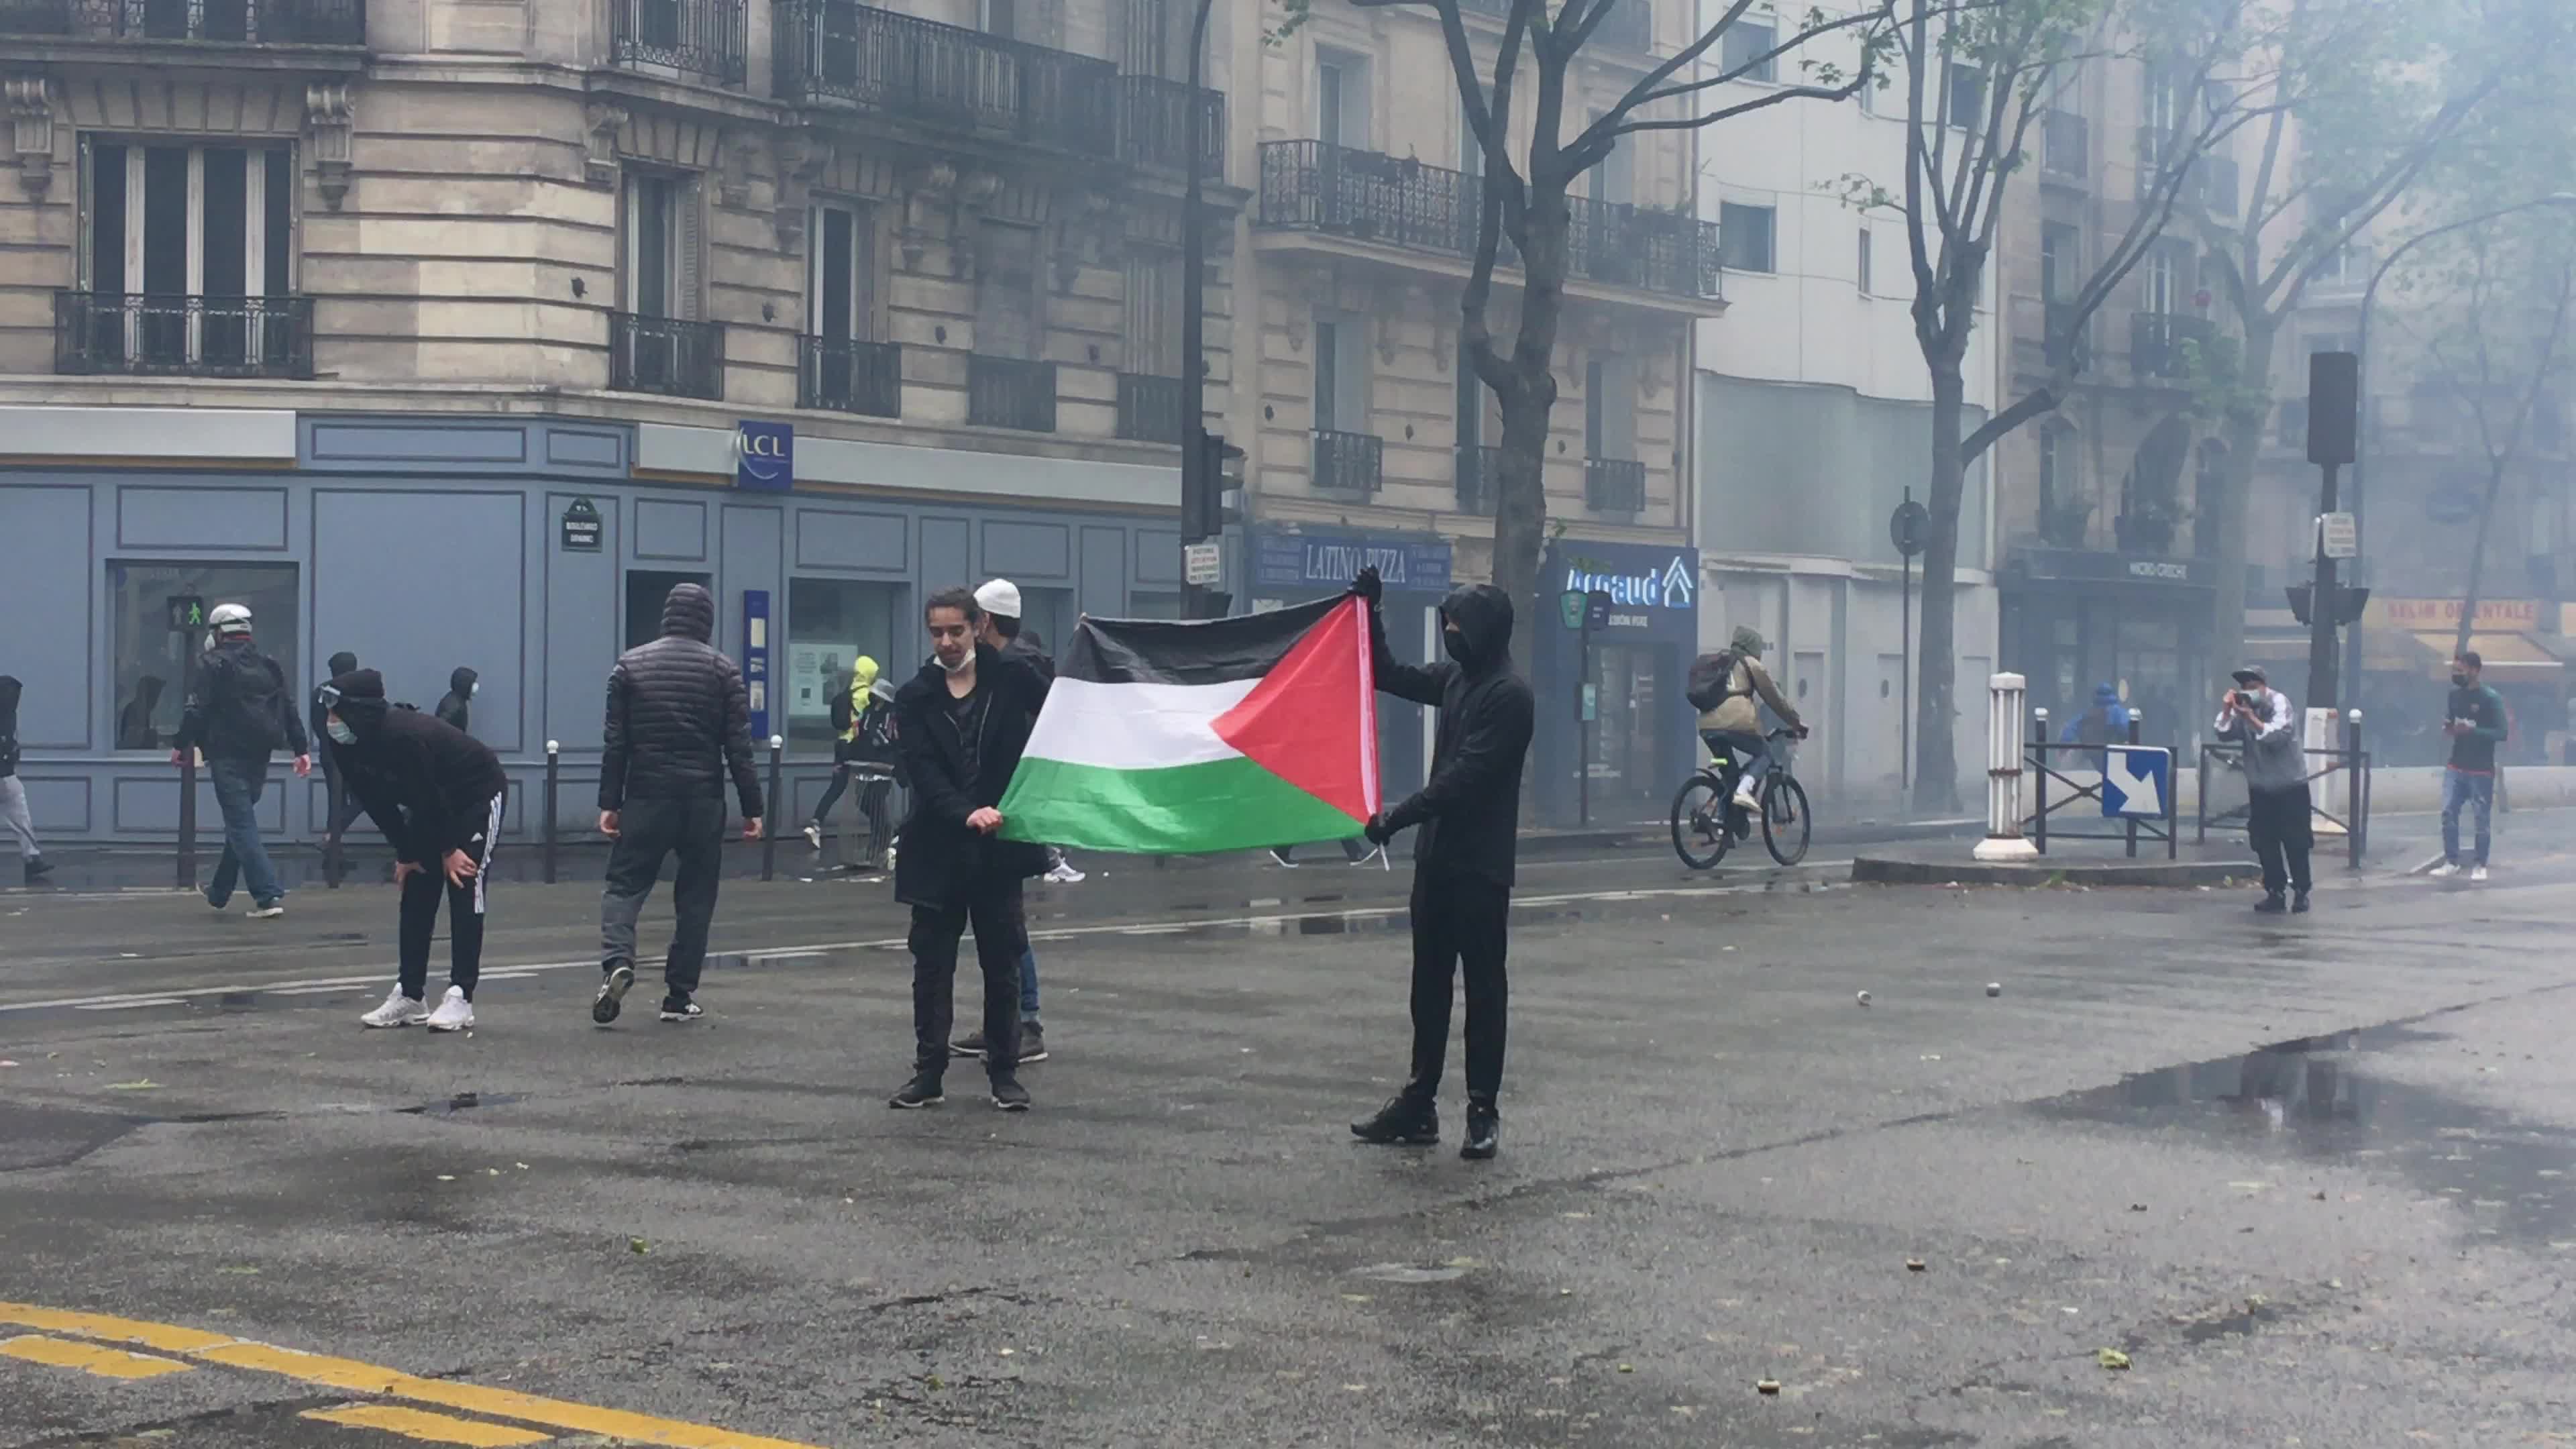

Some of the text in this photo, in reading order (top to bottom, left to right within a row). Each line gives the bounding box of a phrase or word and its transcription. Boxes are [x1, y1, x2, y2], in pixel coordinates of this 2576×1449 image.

[743, 434, 786, 457] LCL
[1305, 544, 1362, 581] LATINO
[1566, 568, 1660, 606] Arnaud
